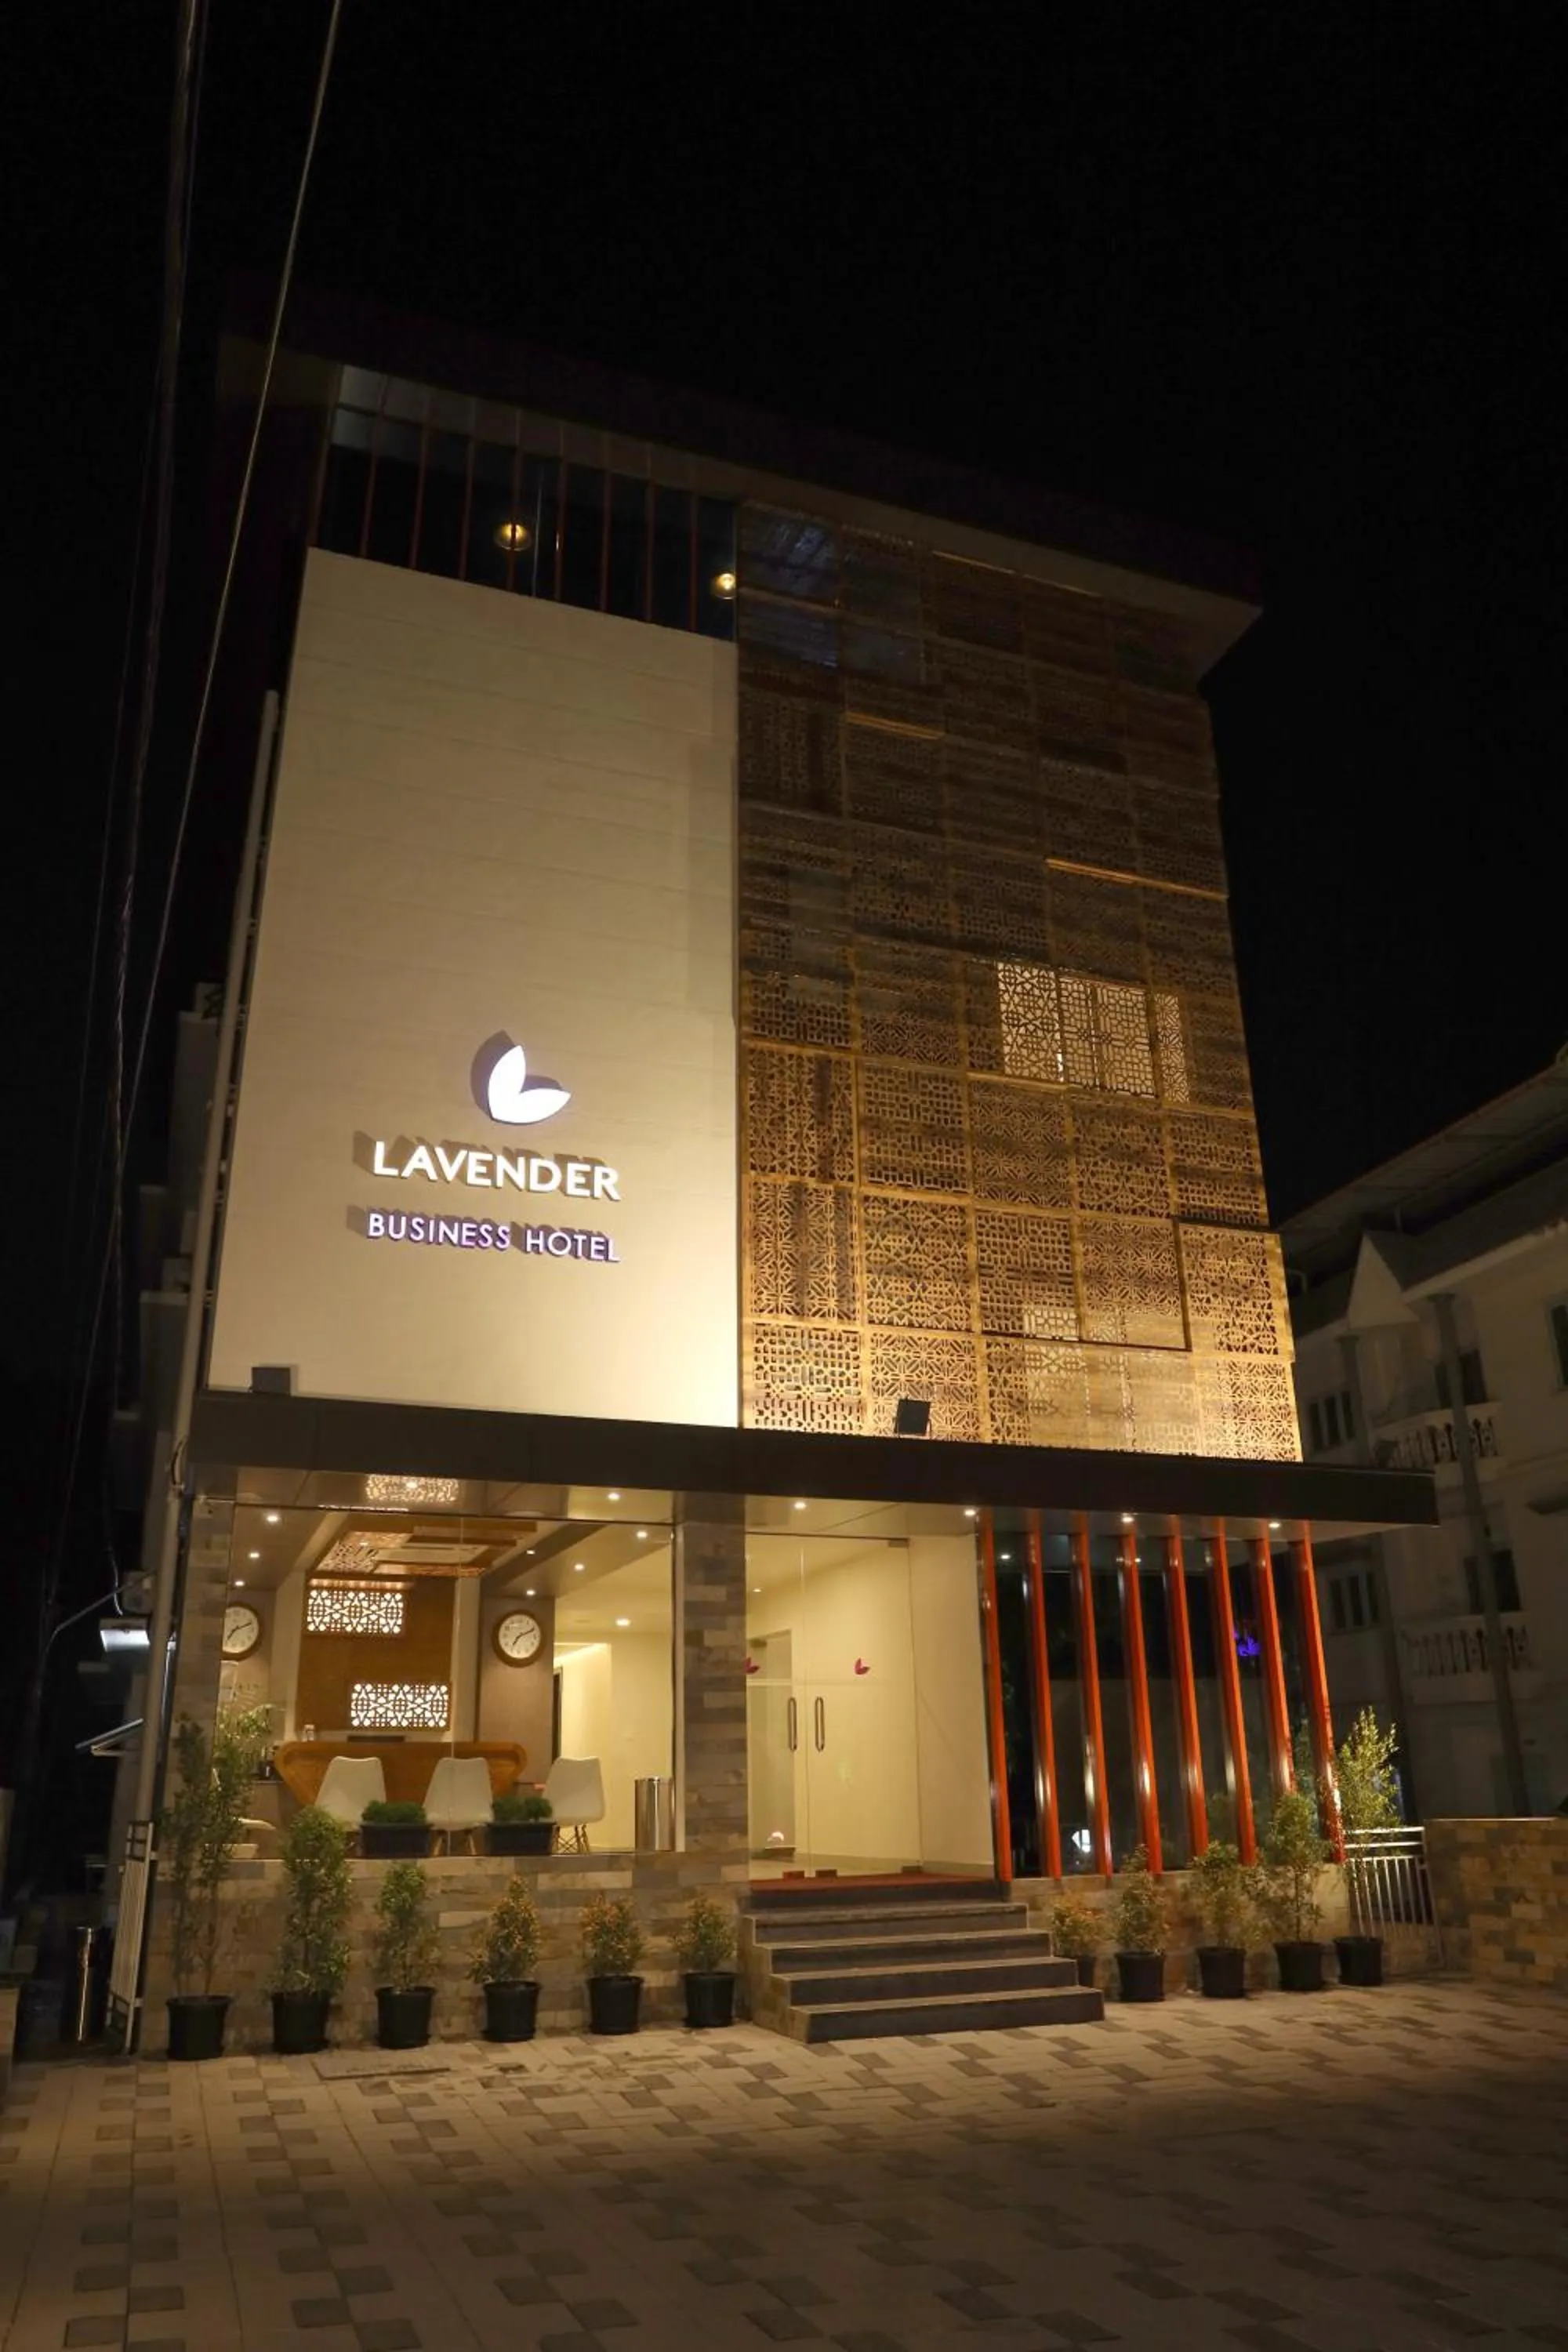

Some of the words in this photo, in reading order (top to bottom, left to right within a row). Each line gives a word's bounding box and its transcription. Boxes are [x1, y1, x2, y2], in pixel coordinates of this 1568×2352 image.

[372, 1141, 622, 1201] LAVENDER
[367, 1212, 510, 1250] BUSINESS
[525, 1229, 621, 1262] HOTEL
